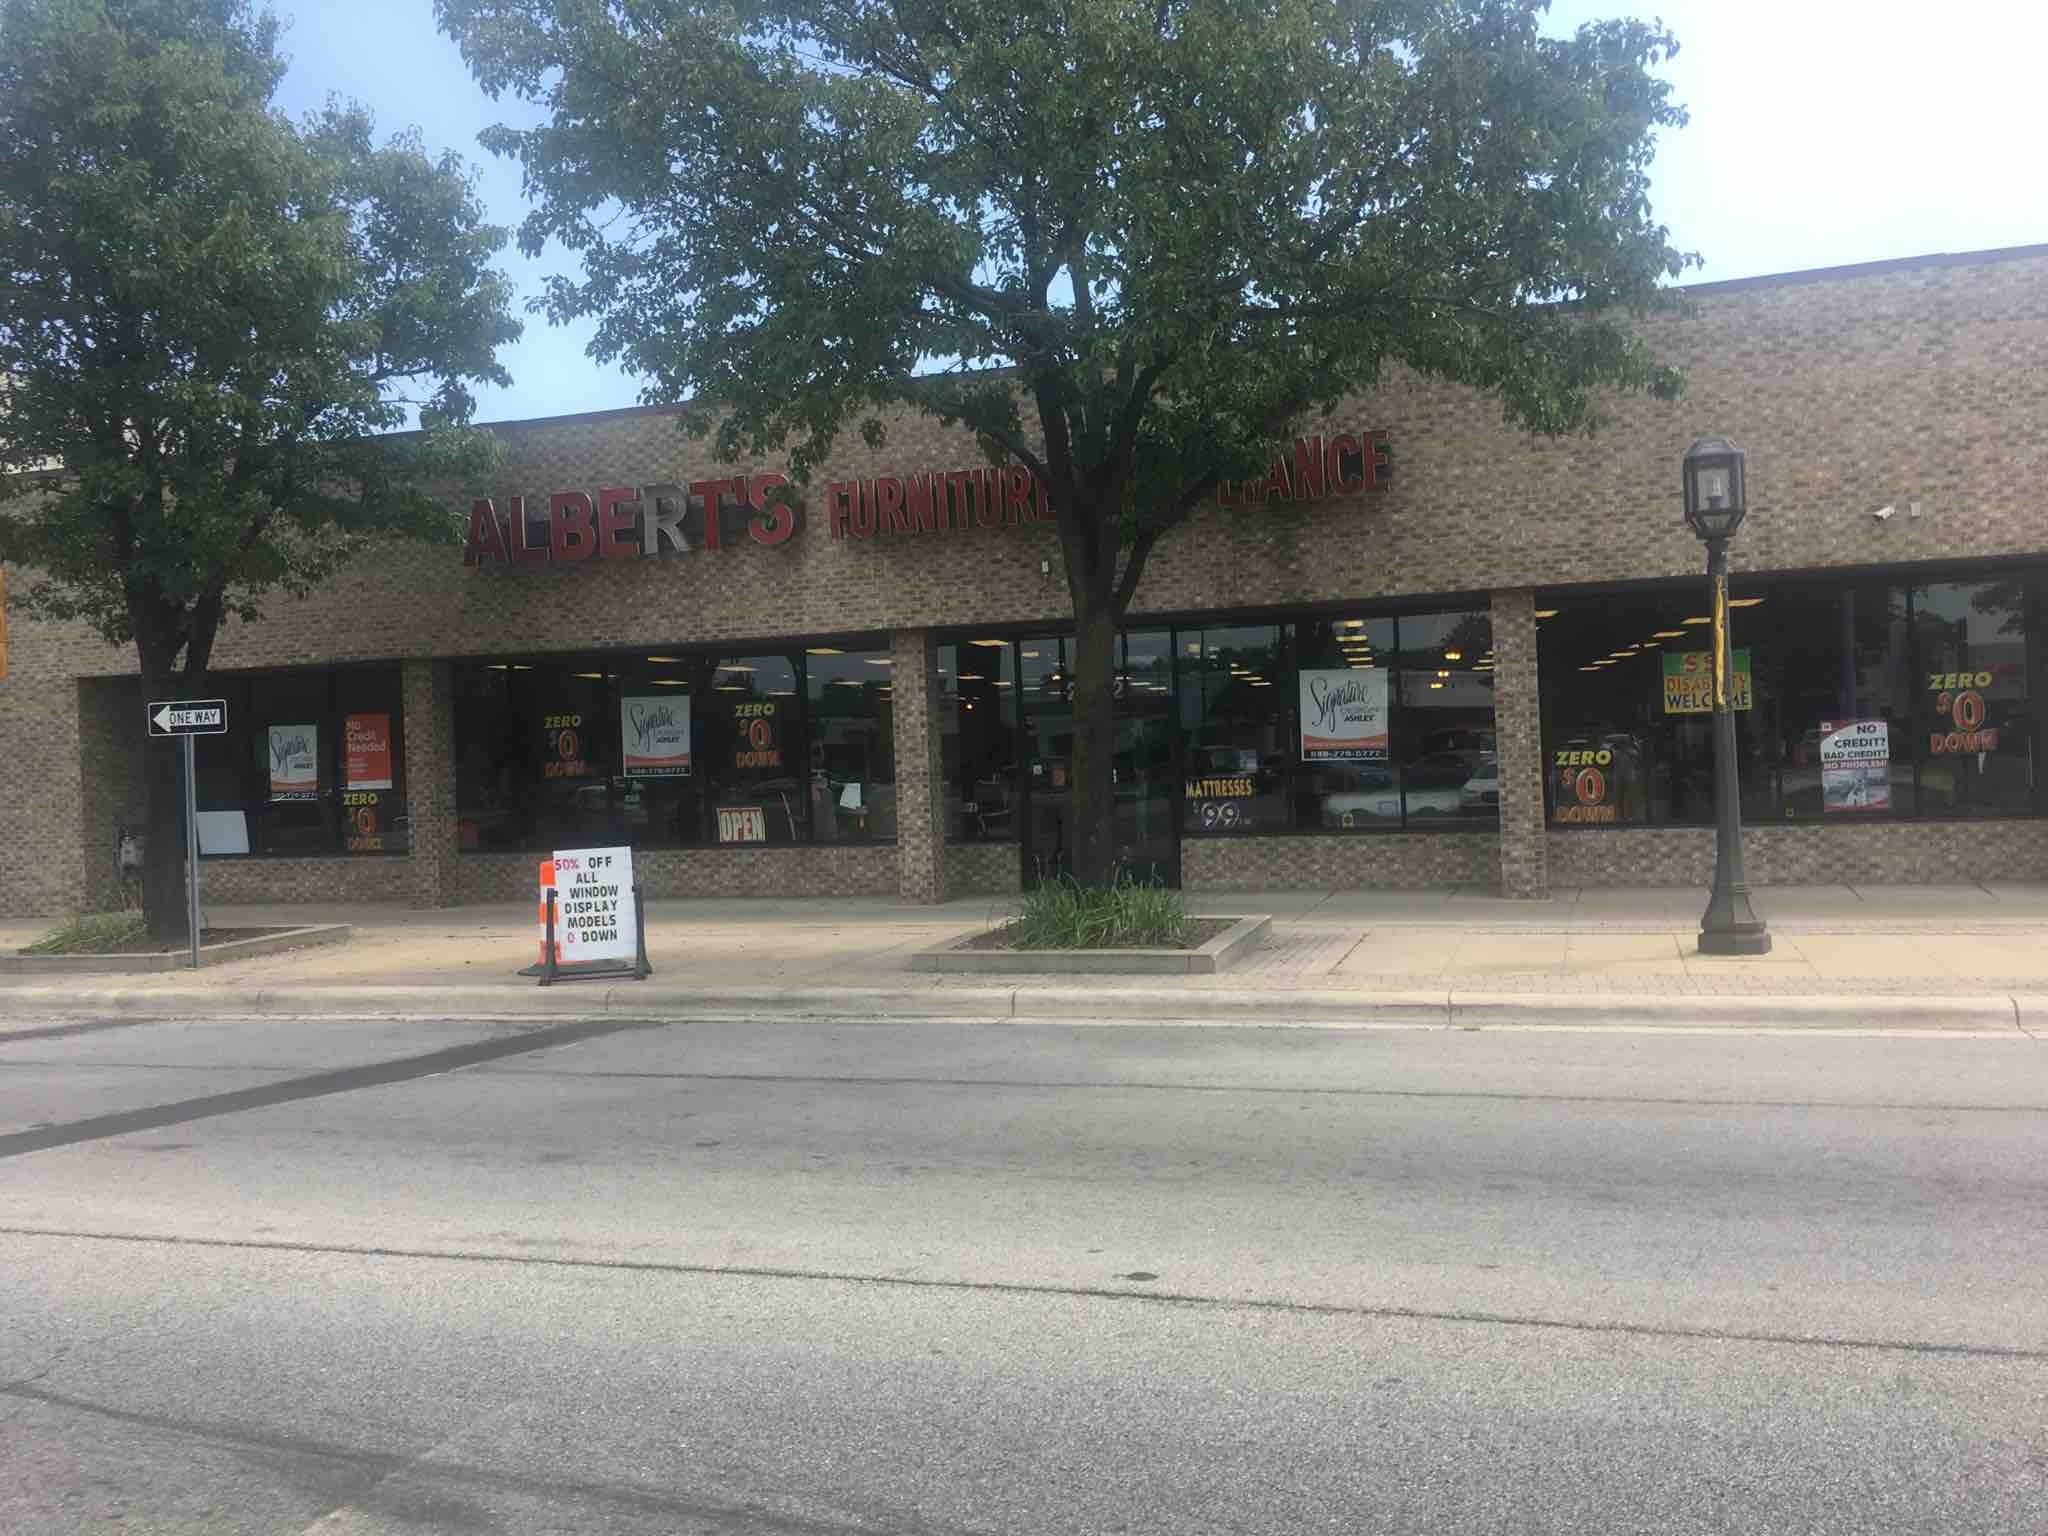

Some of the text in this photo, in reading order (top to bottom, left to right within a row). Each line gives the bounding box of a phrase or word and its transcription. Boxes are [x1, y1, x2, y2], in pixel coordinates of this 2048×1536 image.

[464, 473, 796, 566] ALBERT'S
[829, 466, 1058, 544] FURNITURE
[1928, 673, 1993, 690] ZERO
[1666, 690, 1751, 709] WELCME
[736, 703, 776, 717] ZERO
[169, 711, 217, 724] ONE WAY
[544, 714, 582, 728] ZERO
[1857, 725, 1877, 734] NO
[1834, 738, 1886, 748] CREDIT?
[1555, 751, 1613, 766] ZERO
[1185, 779, 1252, 798] MATTRESSES
[343, 794, 378, 806] ZERO
[720, 812, 766, 841] OPEN
[555, 856, 612, 871] 50% OFF
[575, 871, 599, 884] ALL
[569, 885, 619, 899] WINDOW
[564, 900, 618, 914] DISPLAY
[567, 914, 617, 929] MODELS
[582, 928, 618, 942] DOWN
